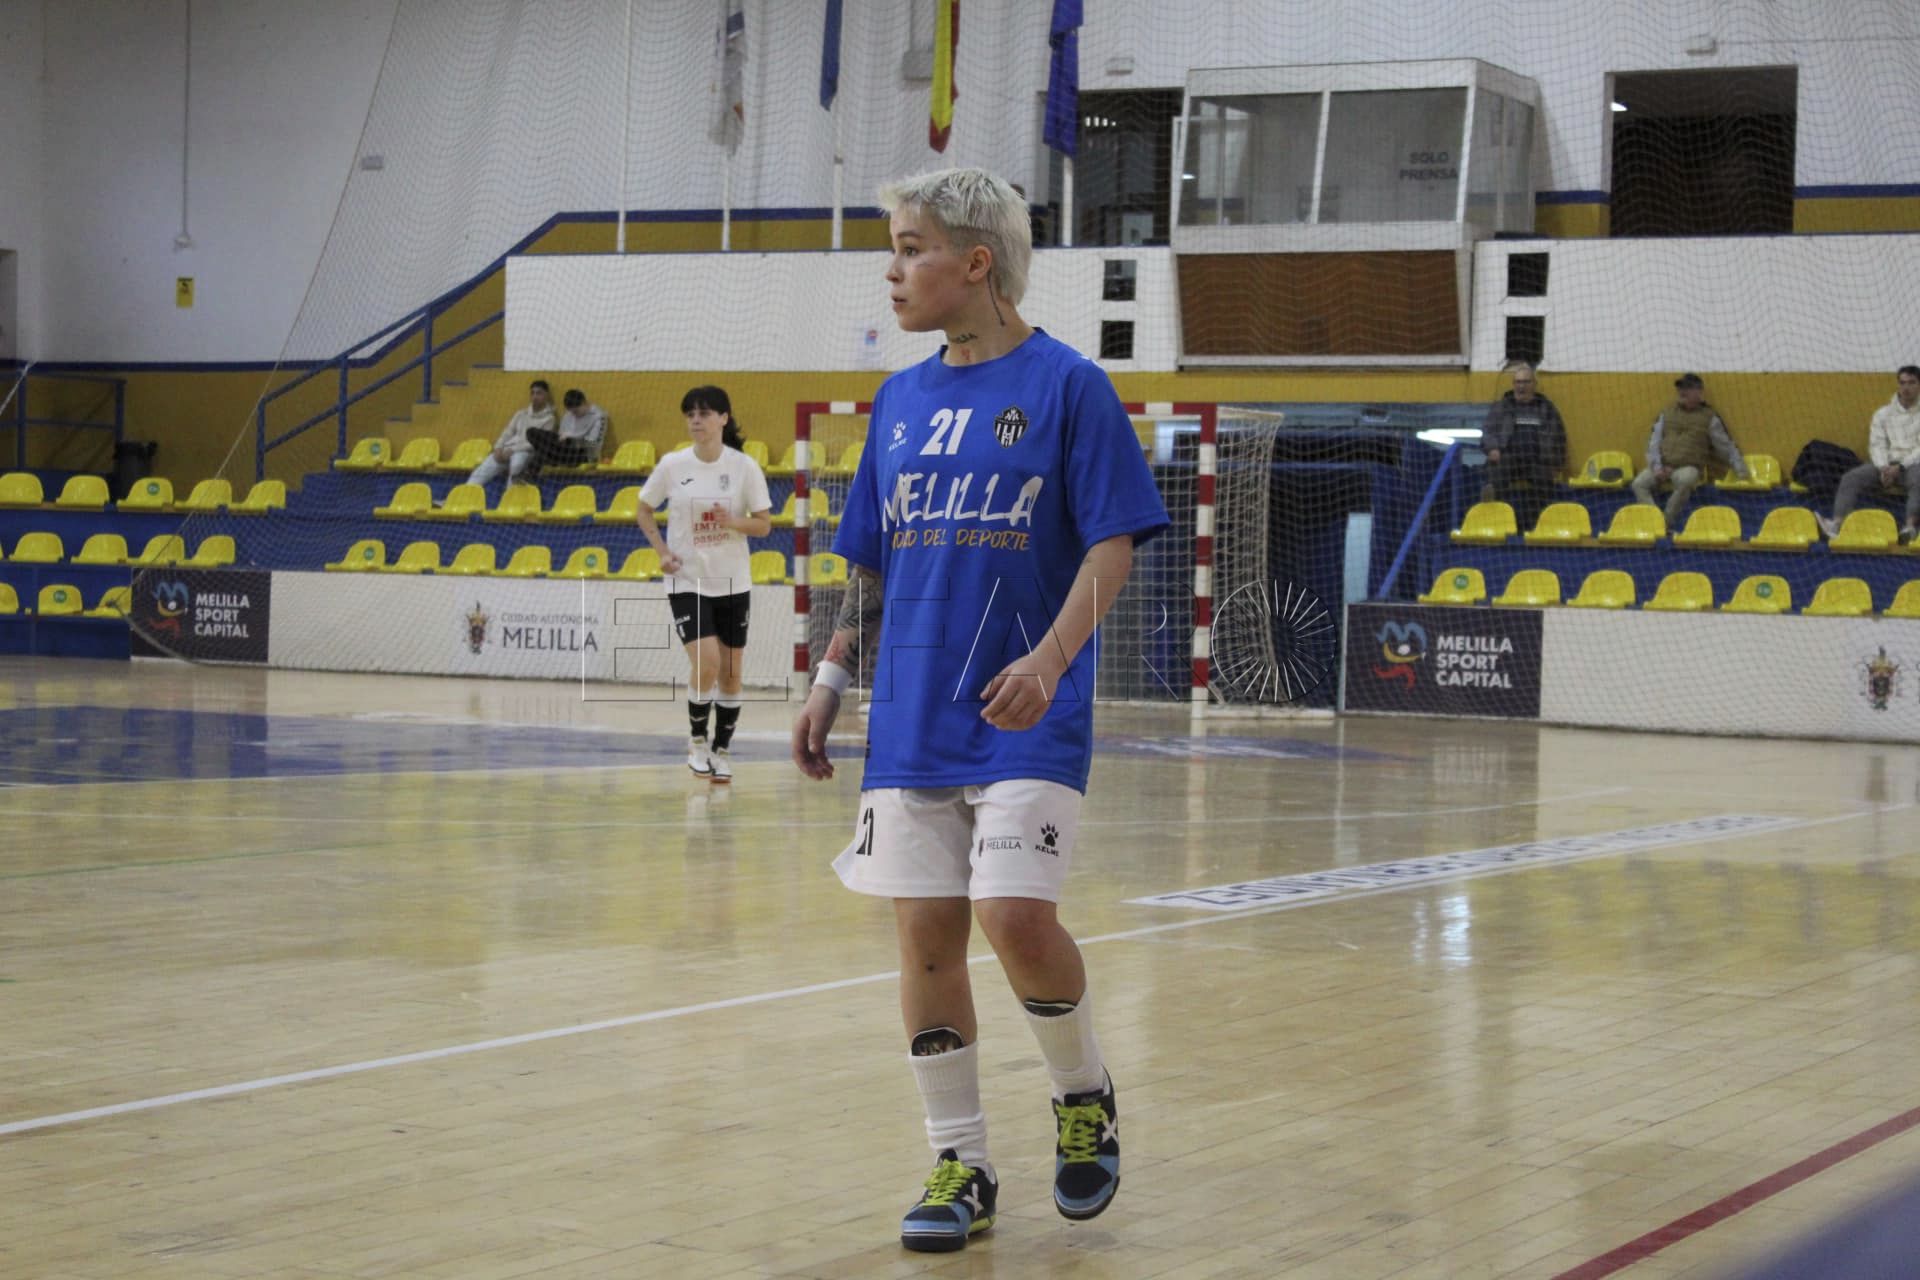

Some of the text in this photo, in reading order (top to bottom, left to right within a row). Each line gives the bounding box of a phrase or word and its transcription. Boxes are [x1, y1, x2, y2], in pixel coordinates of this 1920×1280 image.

[1409, 151, 1449, 165] SOLO
[1399, 167, 1458, 180] PRENSA
[919, 408, 973, 455] 21
[882, 472, 1043, 532] MELILLA
[923, 528, 948, 546] DEL
[956, 528, 1031, 550] DEPORTE
[195, 593, 250, 608] MELILLA
[195, 608, 239, 622] SPORT
[501, 613, 538, 623] CIUDAD
[194, 623, 249, 638] CAPITAL
[503, 626, 598, 652] MELILLA
[1437, 635, 1513, 653] MELILLA
[1436, 653, 1498, 670] SPORT
[1435, 671, 1513, 688] CAPITAL
[987, 840, 1022, 850] MELILLA
